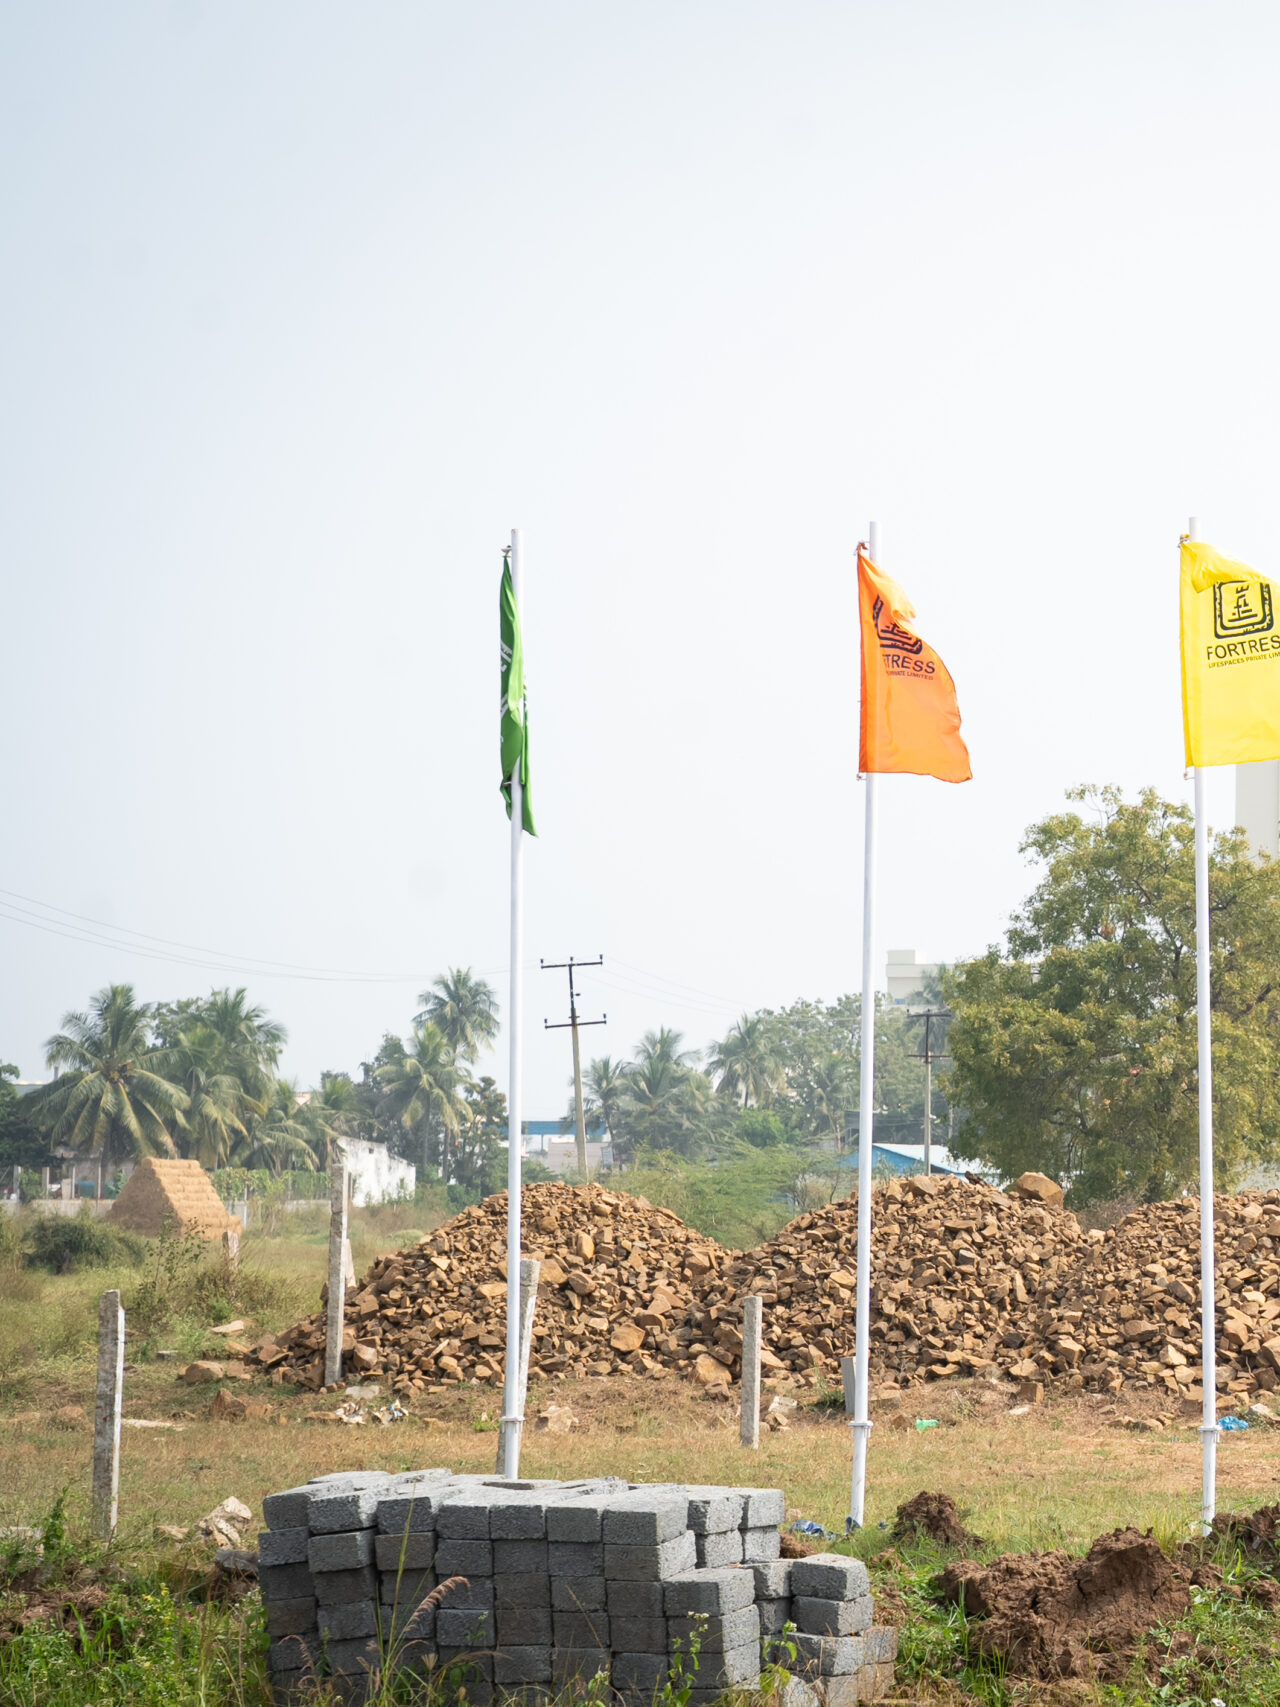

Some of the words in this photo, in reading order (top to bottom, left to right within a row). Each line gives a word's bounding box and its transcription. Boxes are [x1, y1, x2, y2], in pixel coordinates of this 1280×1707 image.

[883, 654, 935, 674] TRESS
[1208, 657, 1245, 669] LIFESPACES
[1246, 653, 1267, 663] PRIVATE
